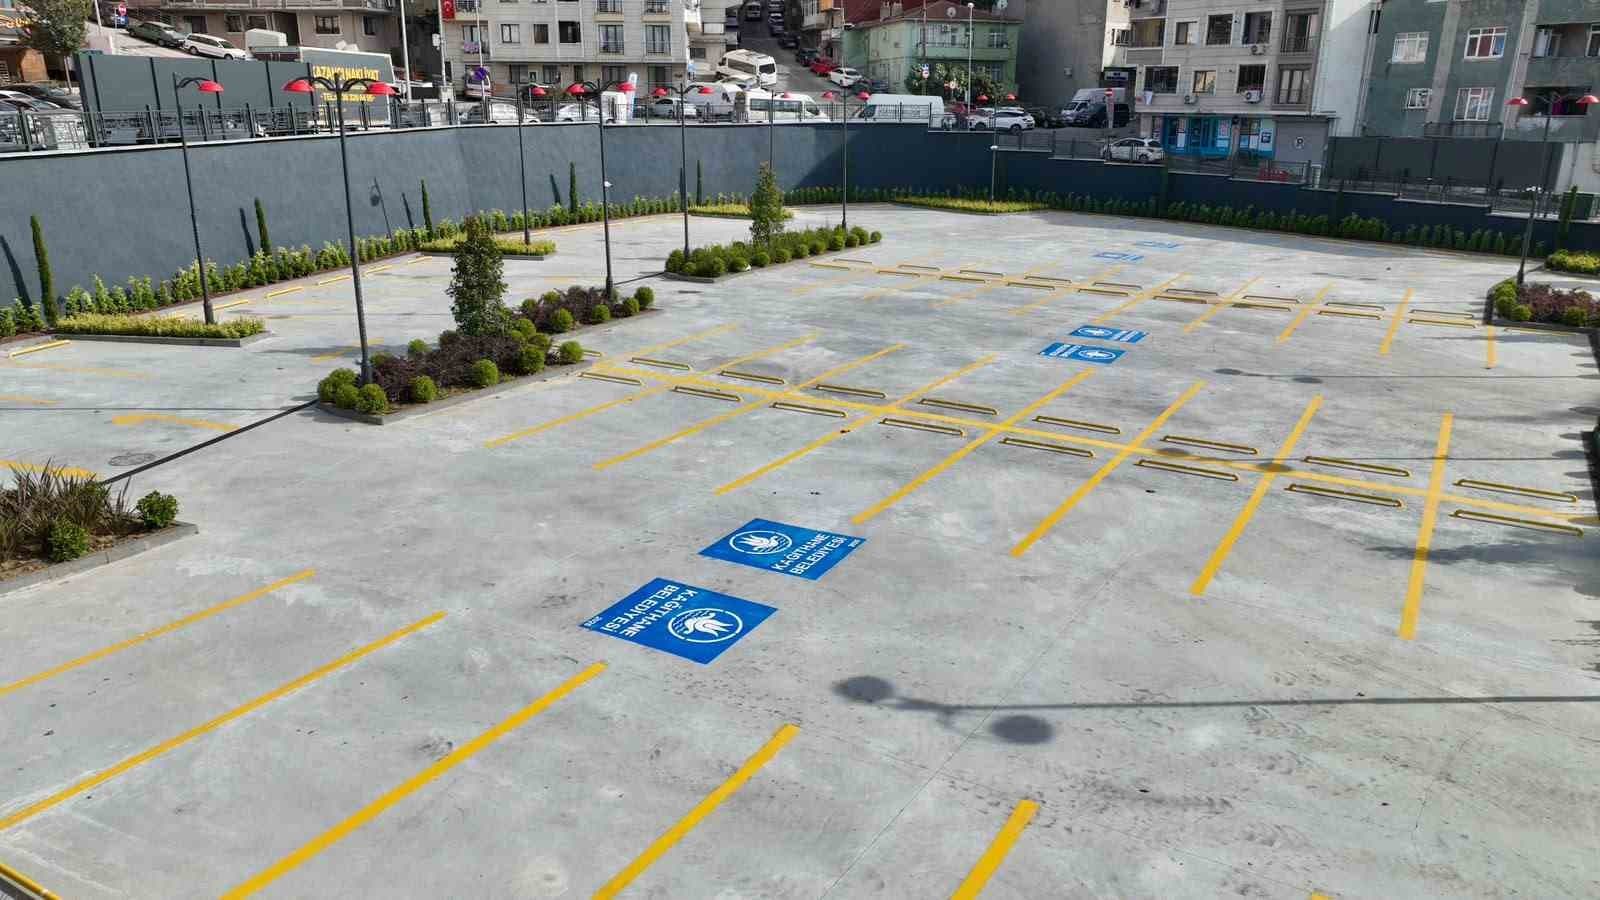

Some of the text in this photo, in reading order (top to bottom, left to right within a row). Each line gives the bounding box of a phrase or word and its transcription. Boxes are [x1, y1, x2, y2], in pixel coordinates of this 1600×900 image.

[771, 533, 829, 570] KAĞITHANE
[789, 536, 848, 575] BELEDİYESİ
[600, 584, 680, 633] BELEDİYESİ
[619, 589, 698, 637] KAĞITHANE
